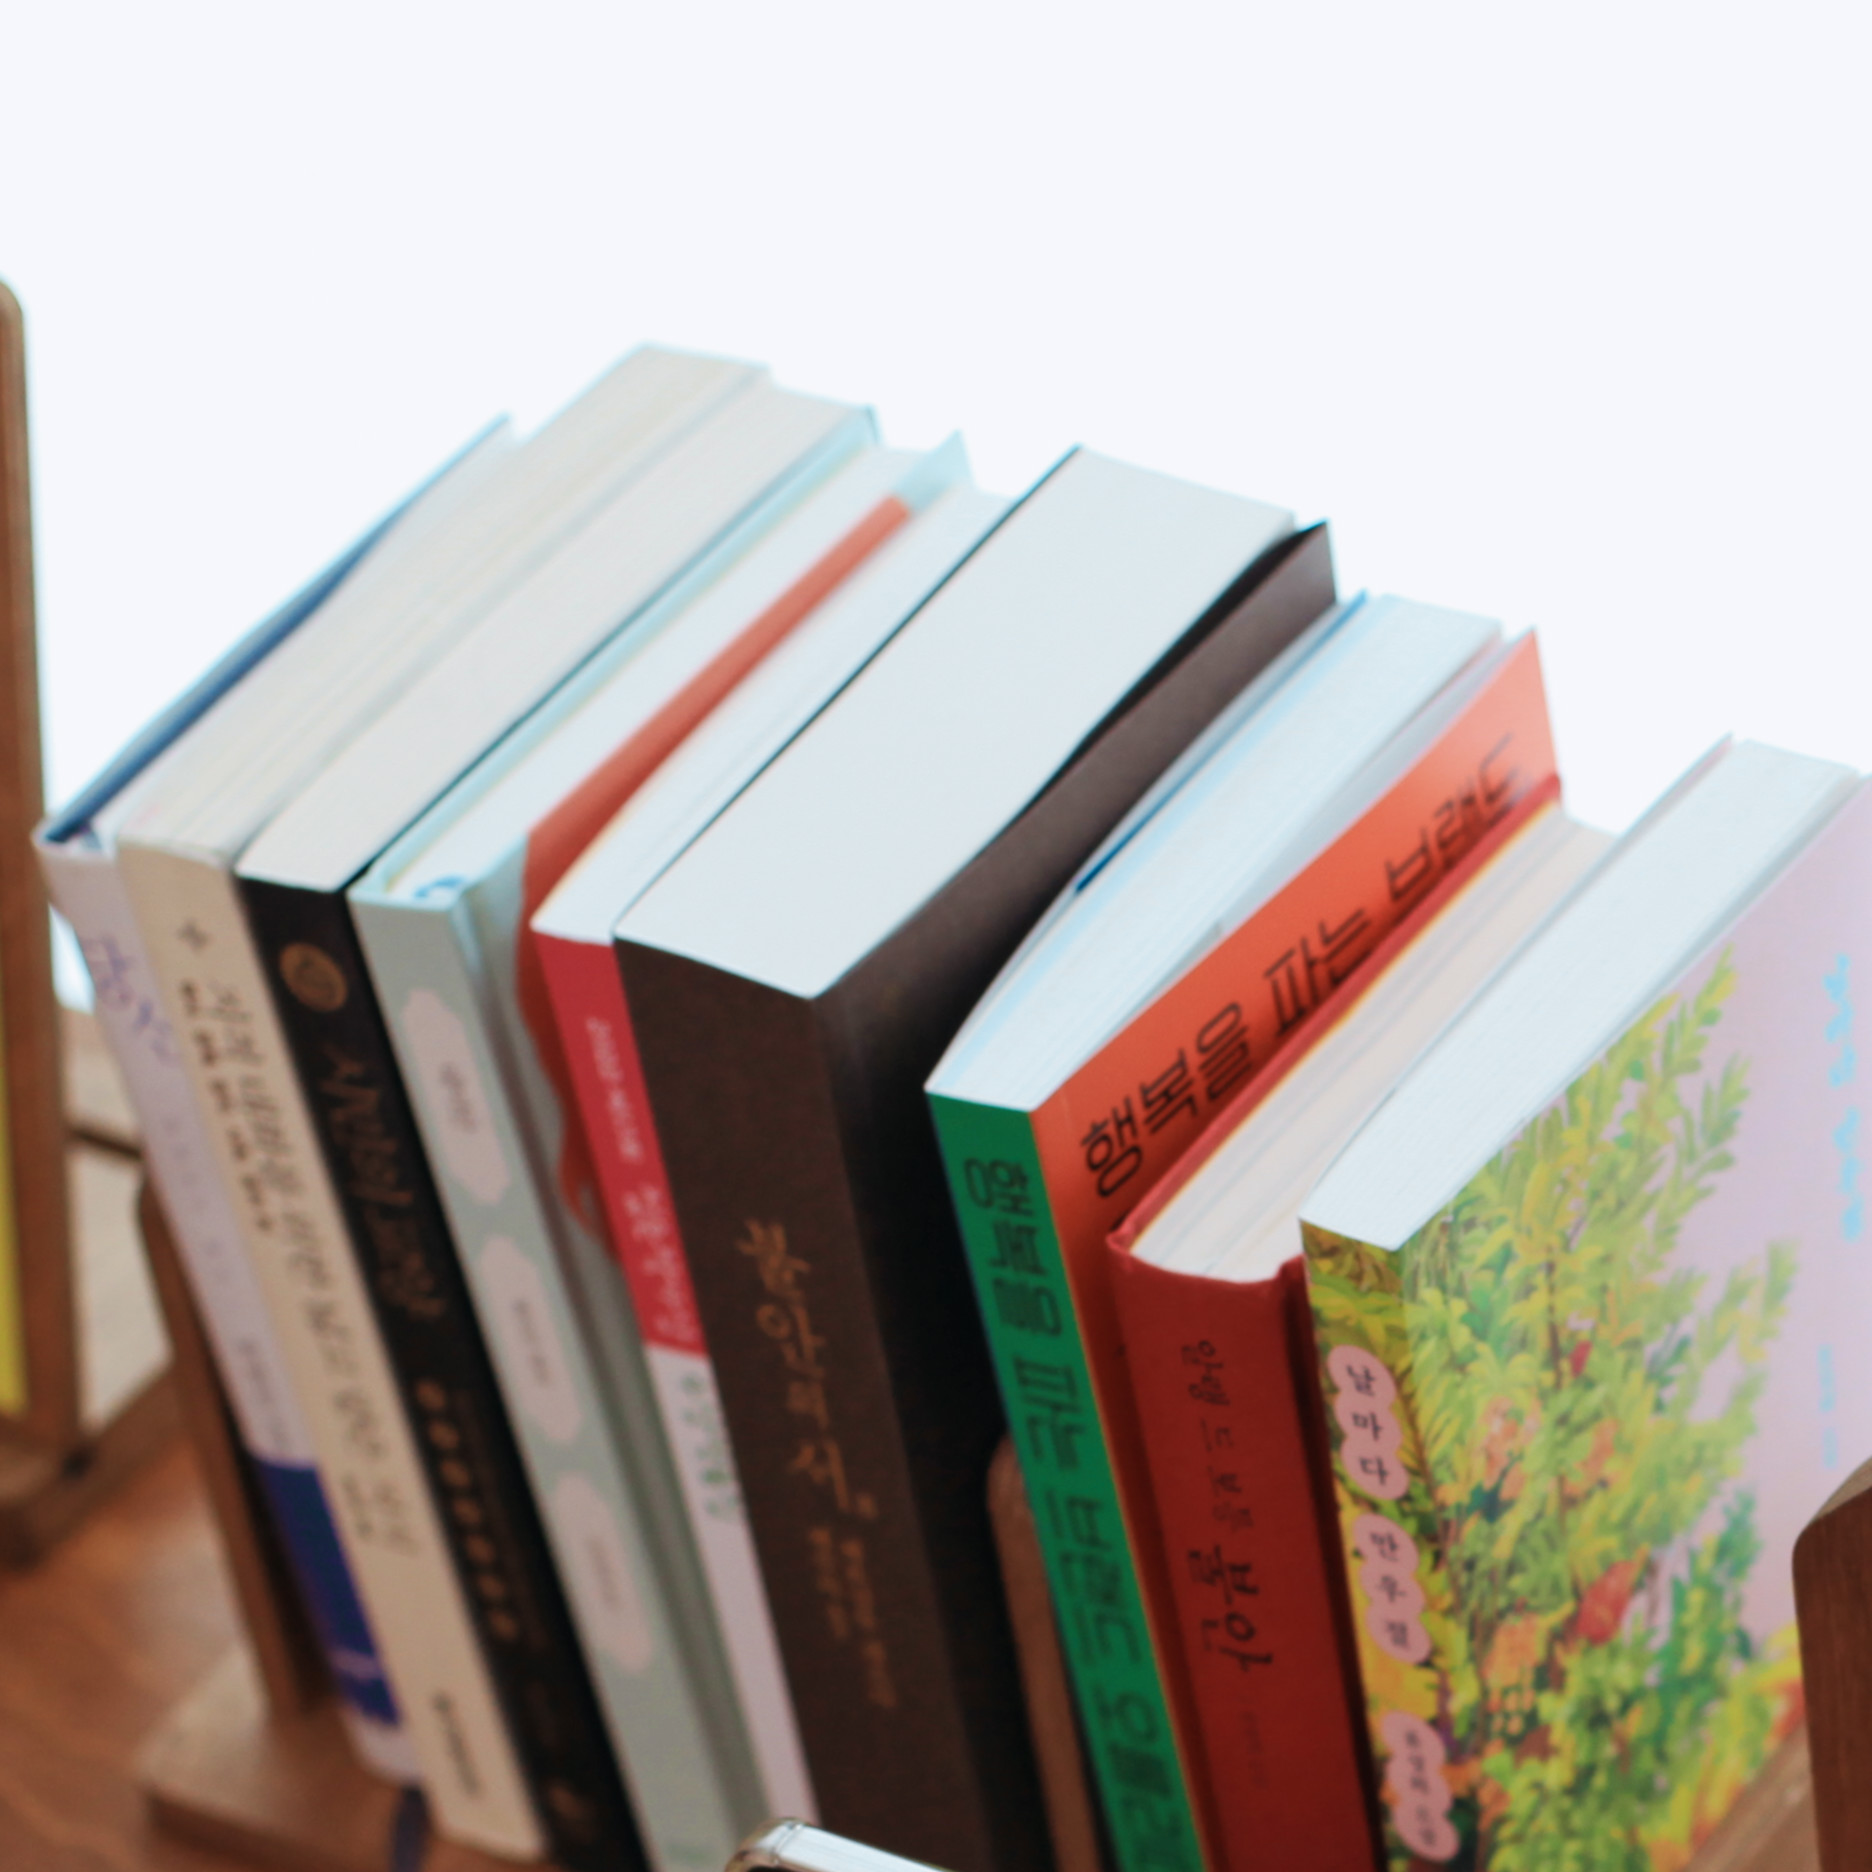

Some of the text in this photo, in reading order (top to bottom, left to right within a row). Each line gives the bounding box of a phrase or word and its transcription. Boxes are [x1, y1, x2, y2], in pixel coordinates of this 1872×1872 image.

[1080, 732, 1535, 1198] 행복을 파는 브랜드
[965, 1157, 1062, 1336] 행복을
[1014, 1355, 1088, 1472] 파는
[1182, 1340, 1254, 1534] 알랭 드 보통
[1346, 1363, 1389, 1487] 날마다
[1045, 1488, 1141, 1665] 브랜드
[1189, 1545, 1273, 1673] 불안
